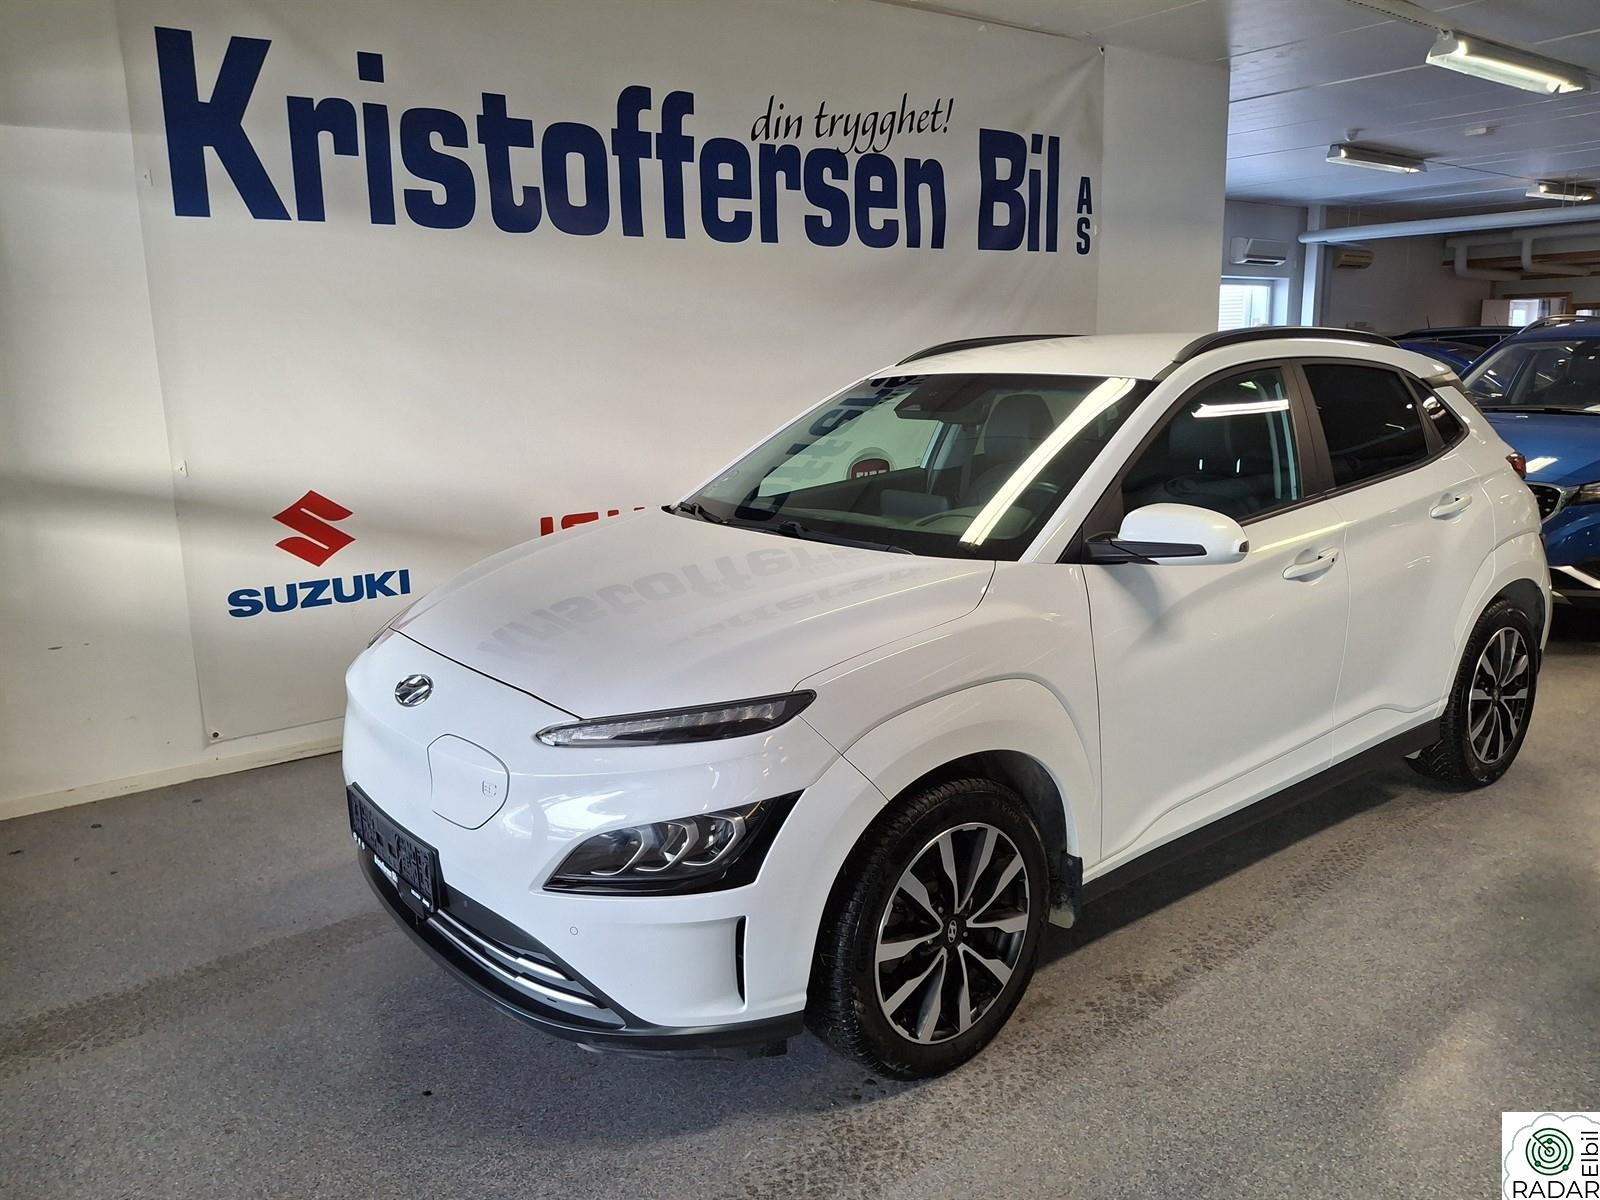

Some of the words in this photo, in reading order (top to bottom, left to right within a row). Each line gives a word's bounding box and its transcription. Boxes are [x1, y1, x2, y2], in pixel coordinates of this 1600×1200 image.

[154, 26, 947, 250] Kristoffersen
[978, 127, 1060, 253] Bil
[751, 95, 802, 141] din
[814, 92, 954, 155] trygghet!
[227, 568, 411, 618] SUZUKI
